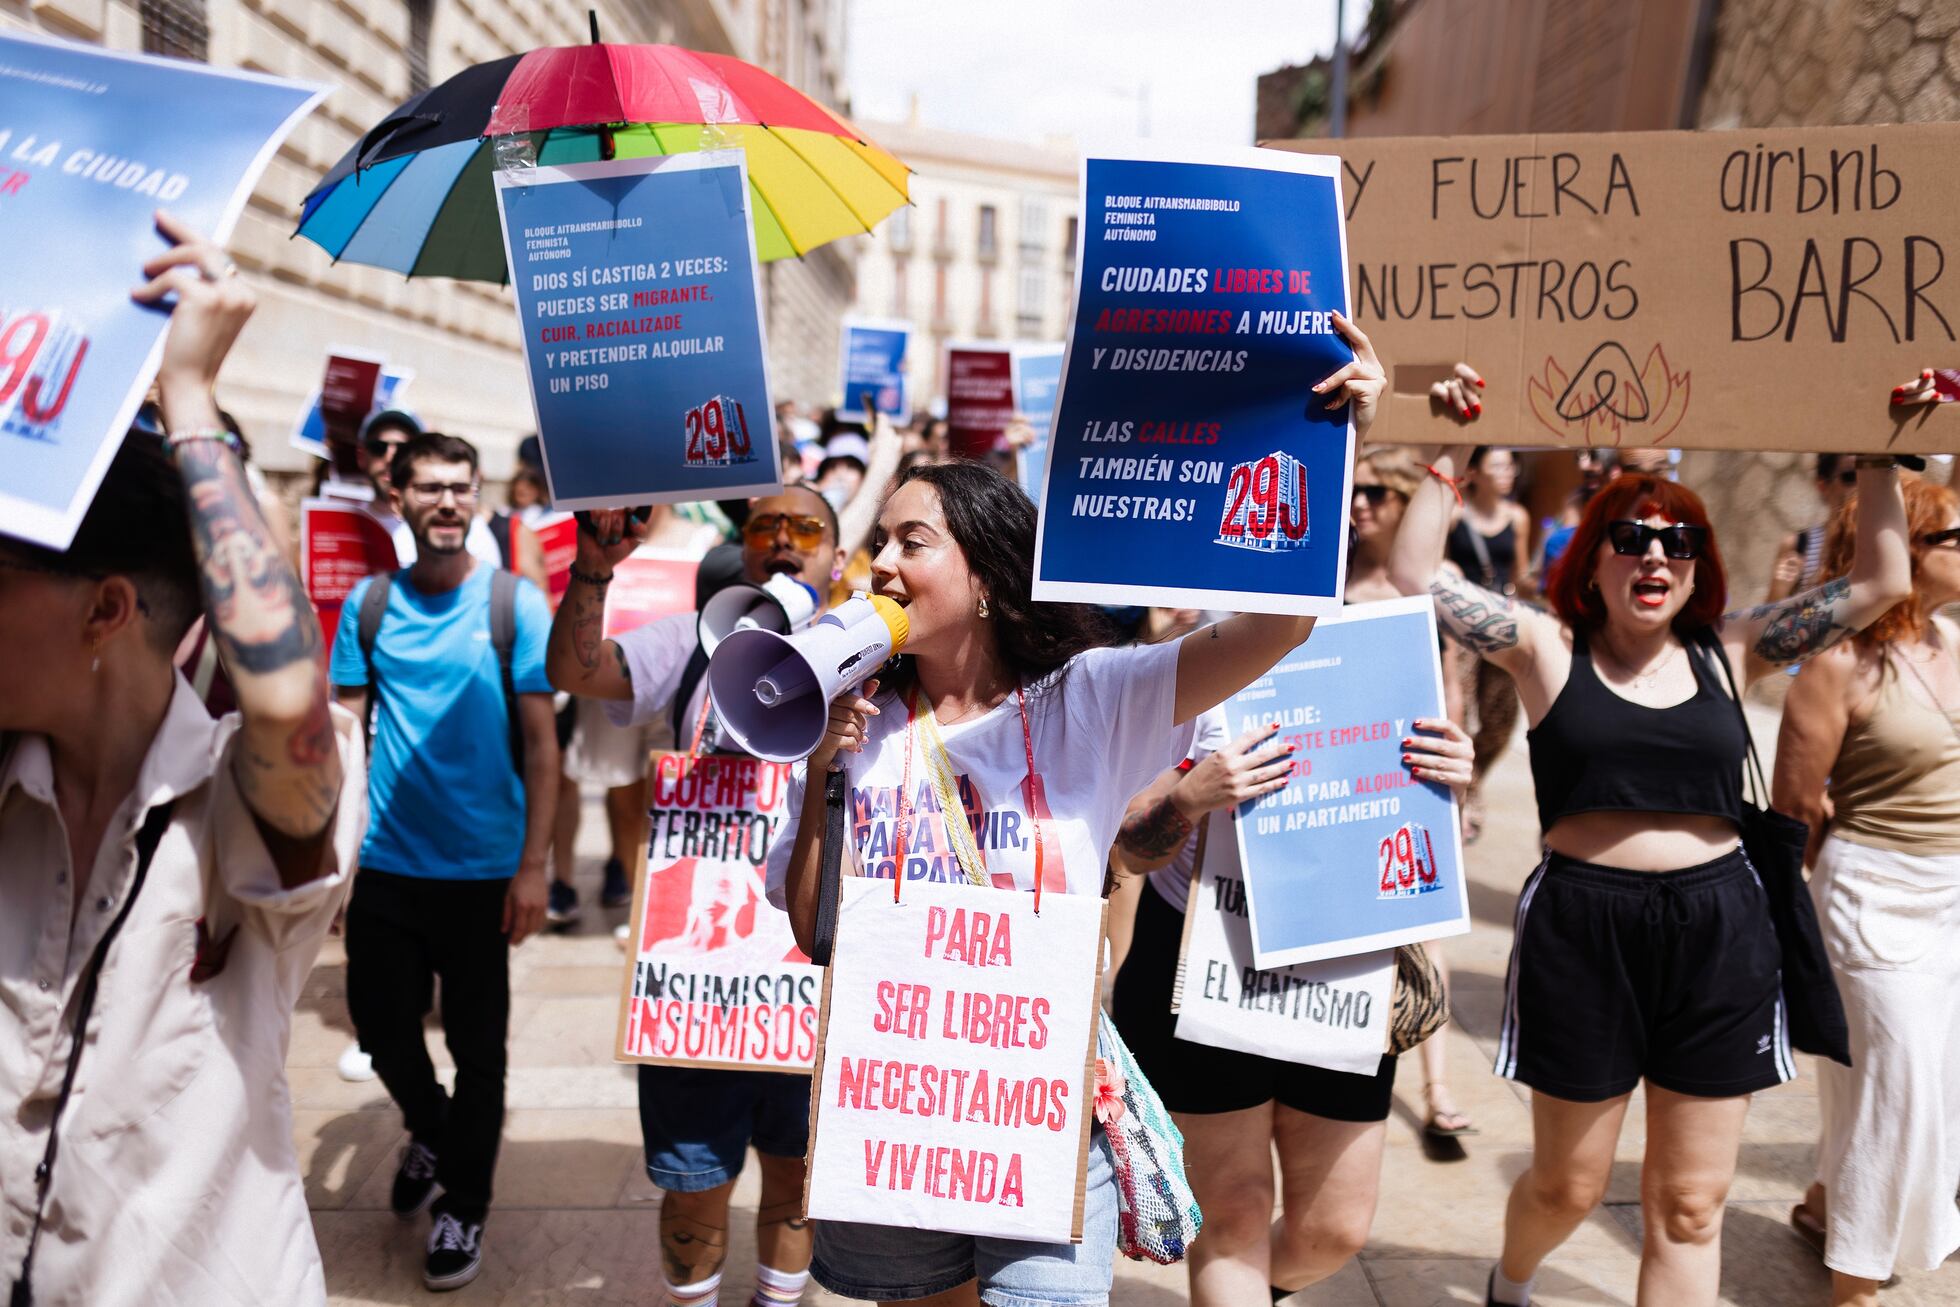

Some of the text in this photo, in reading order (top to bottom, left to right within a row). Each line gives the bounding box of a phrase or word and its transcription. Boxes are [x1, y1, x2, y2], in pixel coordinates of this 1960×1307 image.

[10, 133, 62, 167] LA
[61, 147, 190, 200] CIUDAD
[1343, 143, 1903, 221] Y FUERA airbnb
[1104, 195, 1241, 213] BLOQUE AITRANSMARIBIBOLLO
[1104, 212, 1156, 226] FEMINISTA
[524, 226, 556, 238] BLOQUE
[526, 237, 569, 250] FEMINISTA
[1103, 227, 1157, 242] AUTÓNOMO
[528, 248, 572, 262] AUTÓNOMO
[533, 256, 728, 292] DIOS SÍ CASTIGA 2 VECES:
[1100, 266, 1312, 295] CIUDADES LIBRES DE
[1356, 259, 1640, 323] NUESTROS
[537, 284, 714, 318] PUEDES SER MIGRANTE,
[541, 315, 683, 344] CUIR, RACIALIZADE
[1094, 308, 1341, 336] AGRESIONES A MUJERE
[546, 335, 725, 369] Y PRETENDER ALQUILAR
[1092, 348, 1249, 373] Y DISIDENCIAS
[550, 372, 609, 394] UN PISO
[686, 399, 753, 462] 29J
[1081, 421, 1222, 445] ¡LAS CALLES
[1079, 453, 1225, 484] TAMBIÉN SON
[1071, 494, 1197, 521] NUESTRAS!
[1218, 456, 1309, 541] 29J
[1329, 721, 1391, 747] EMPLEO
[1394, 719, 1406, 737] Y
[654, 754, 793, 812] CUERPO
[1281, 787, 1304, 807] DA
[1308, 779, 1350, 801] PARA
[1257, 796, 1400, 835] UN APARTAMENTO
[648, 809, 779, 866] TERRITO
[1378, 827, 1437, 892] 29J
[924, 905, 1012, 968] PARA
[1203, 959, 1372, 1030] EL RENTISMO
[627, 998, 818, 1063] INSUMISOS
[873, 980, 1050, 1050] SER LIBRES
[837, 1056, 1069, 1132] NECESITAMOS
[864, 1139, 1024, 1208] VIVIENDA
